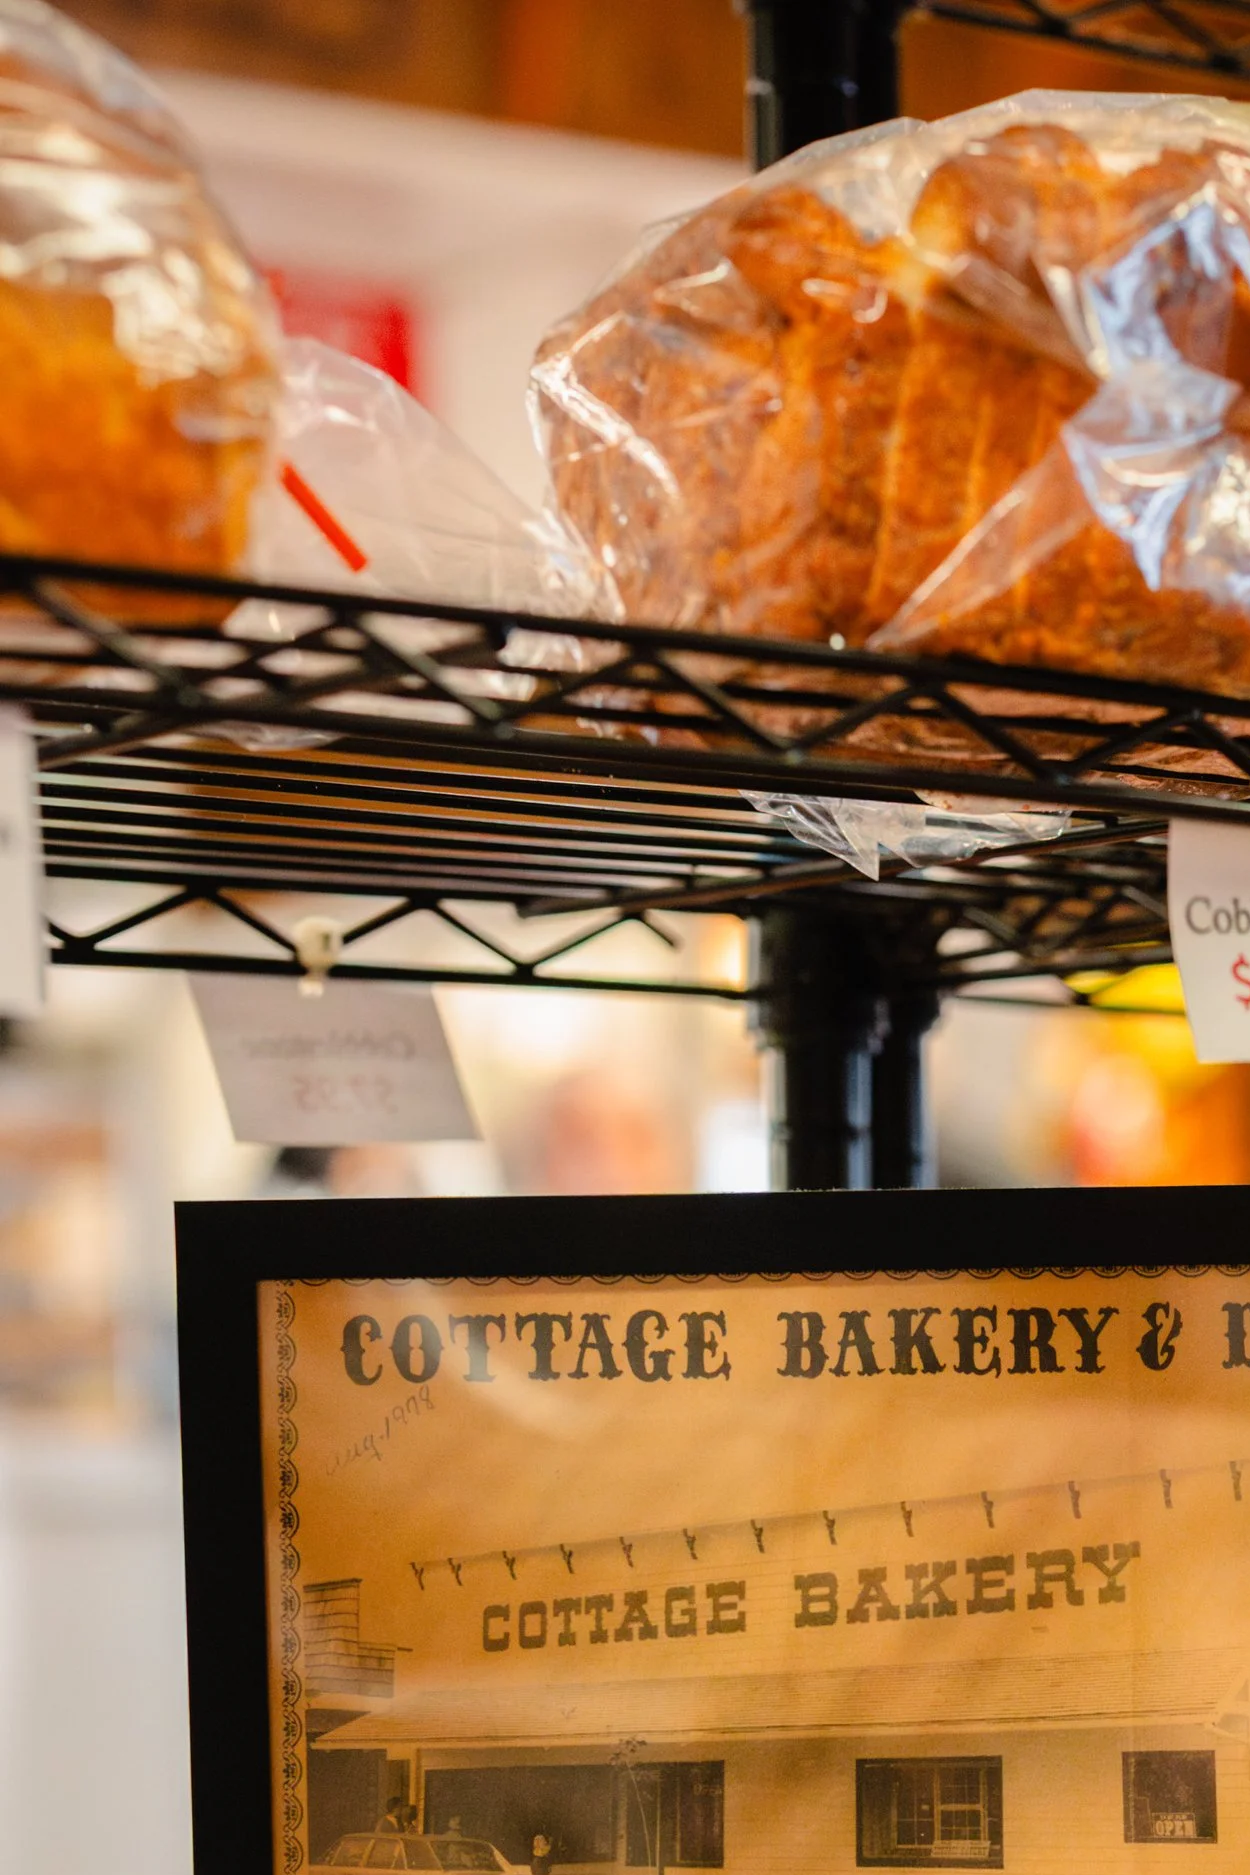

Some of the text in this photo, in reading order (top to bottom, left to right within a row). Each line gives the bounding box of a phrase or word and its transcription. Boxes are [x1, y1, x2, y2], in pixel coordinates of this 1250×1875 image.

[341, 1310, 731, 1385] COTTAGE
[777, 1305, 1119, 1378] BAKERY
[1136, 1302, 1183, 1371] &
[483, 1541, 1140, 1652] COTTAGE BAKERY
